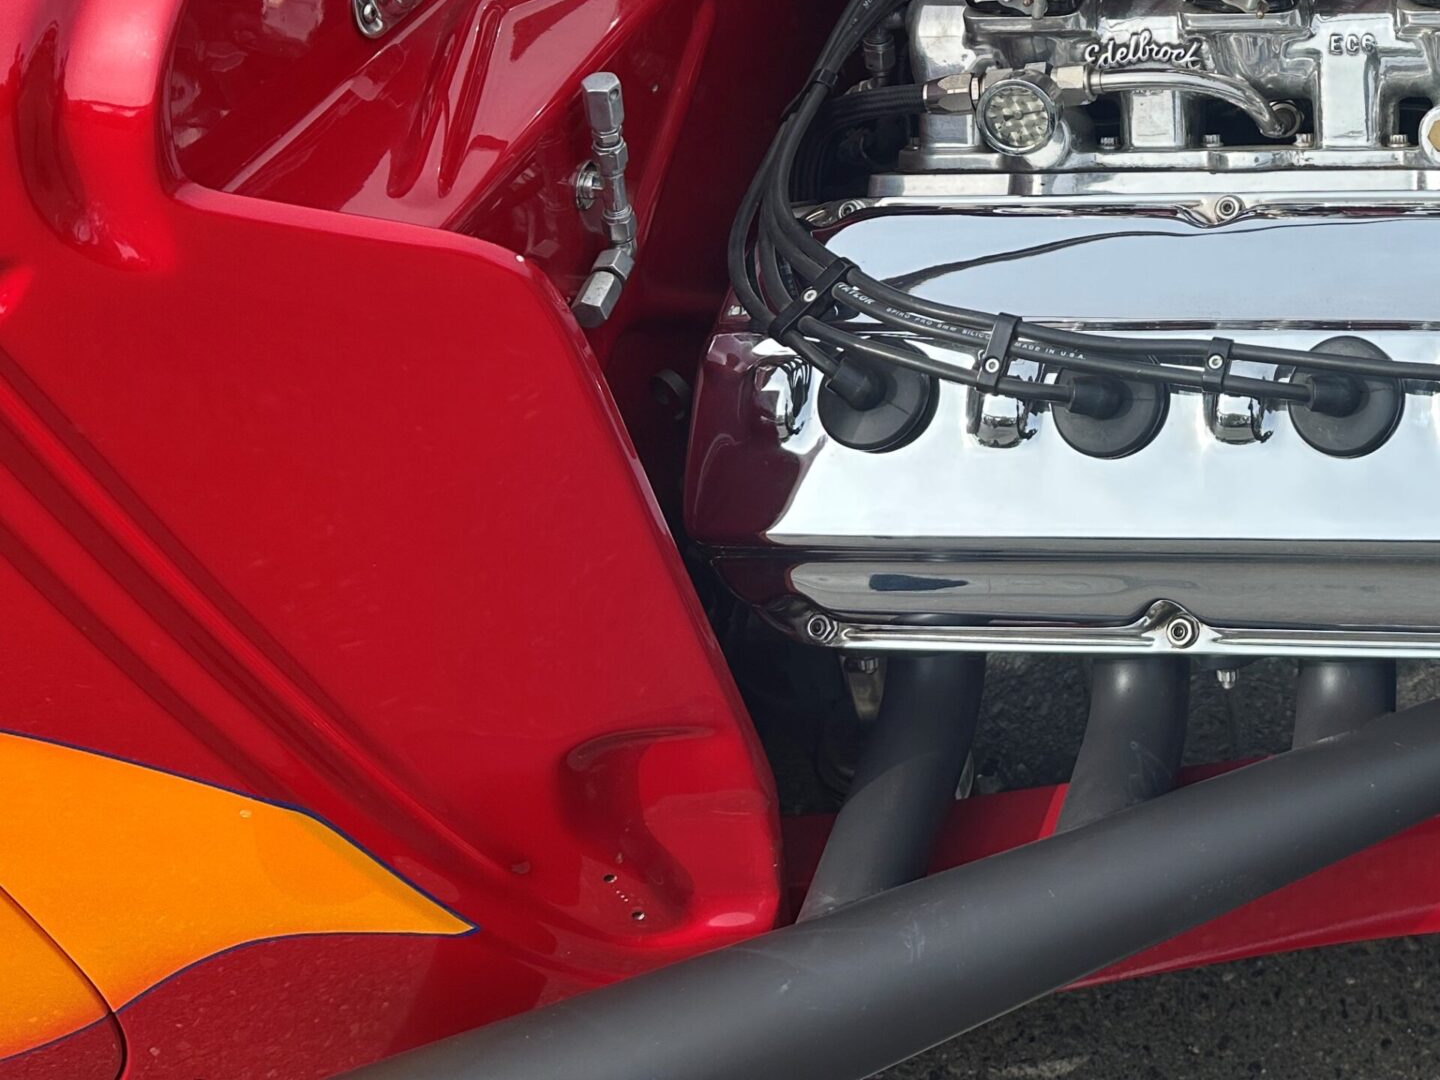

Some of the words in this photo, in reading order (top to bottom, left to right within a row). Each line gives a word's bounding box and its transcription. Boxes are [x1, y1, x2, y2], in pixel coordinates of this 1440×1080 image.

[1084, 29, 1202, 69] Edelbrock
[837, 283, 876, 306] TAYLOR
[914, 316, 934, 327] PRO
[1014, 341, 1041, 352] MADE
[1045, 347, 1056, 355] IN
